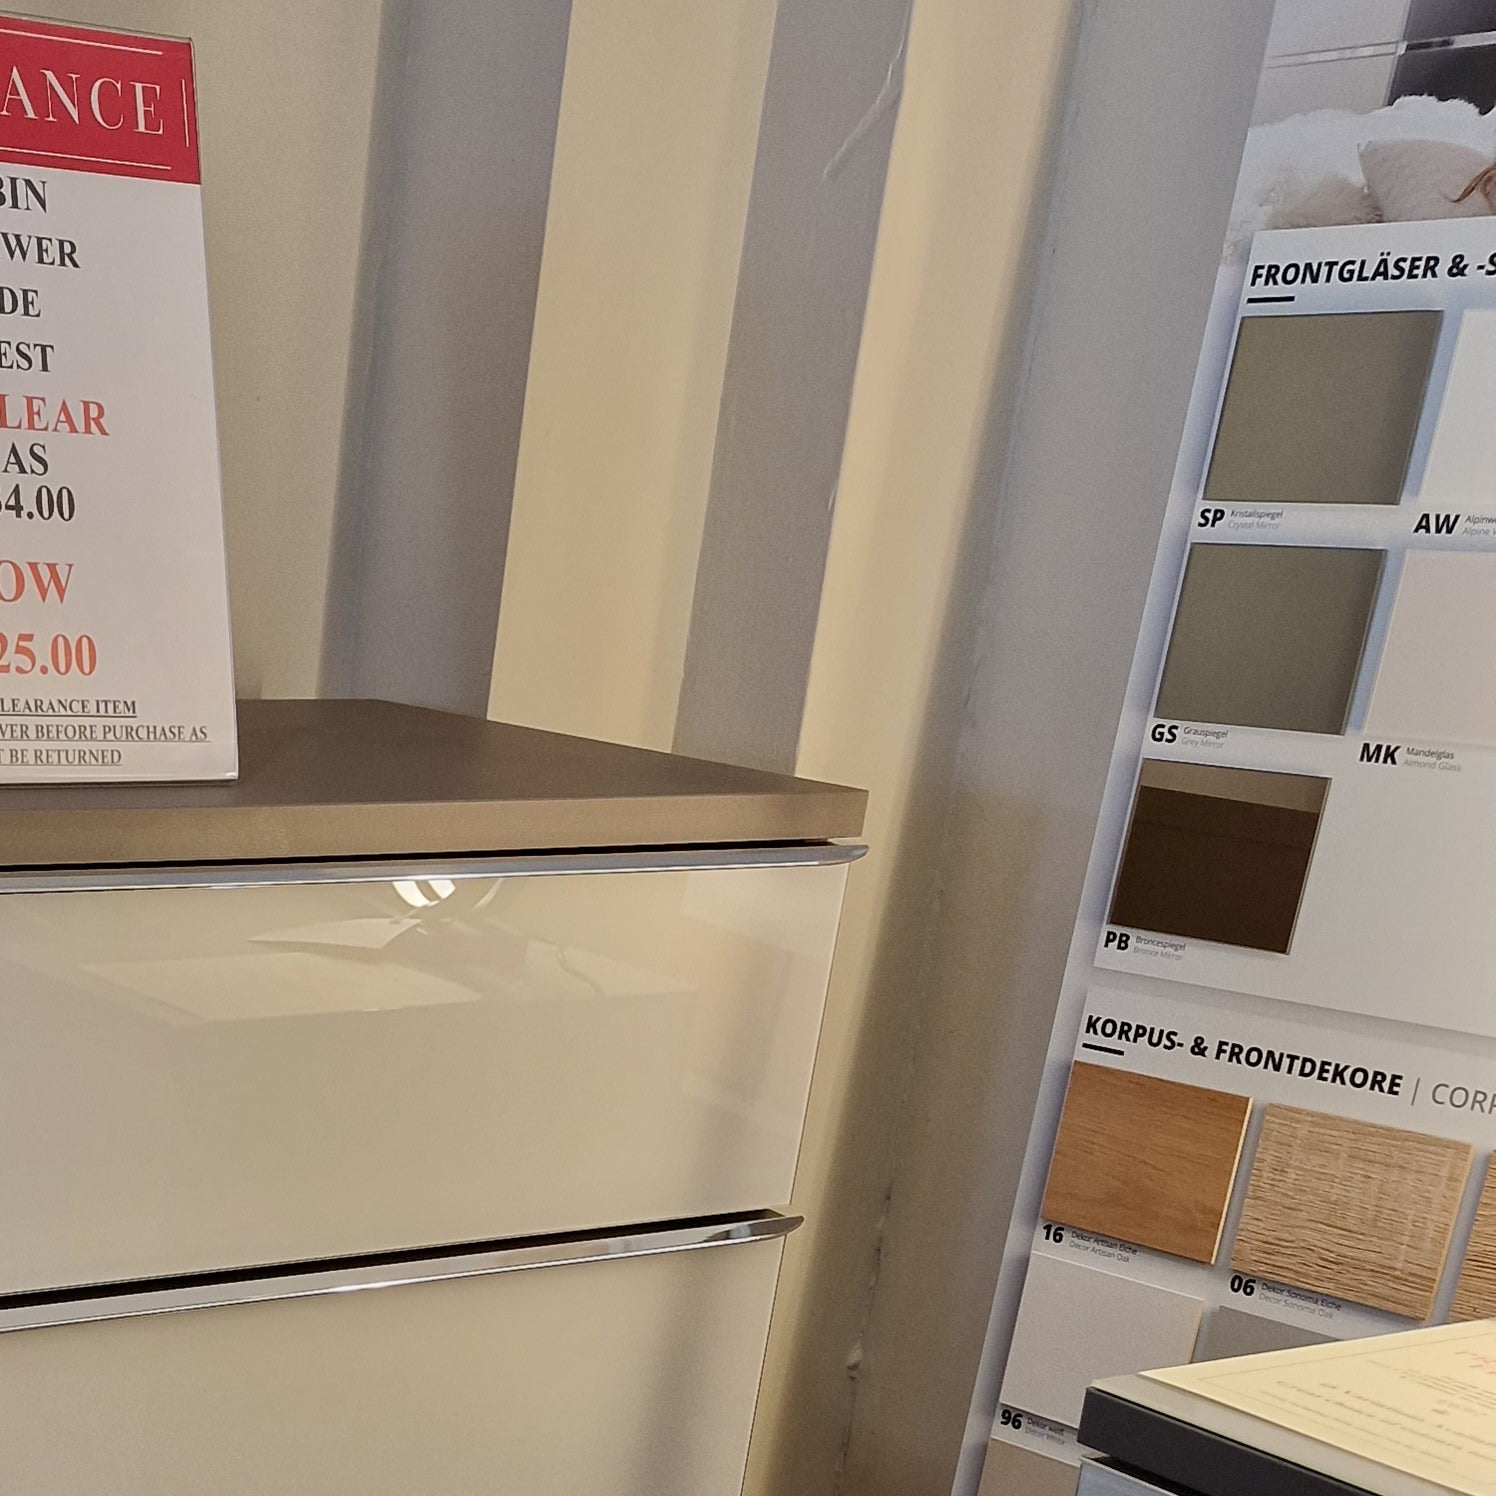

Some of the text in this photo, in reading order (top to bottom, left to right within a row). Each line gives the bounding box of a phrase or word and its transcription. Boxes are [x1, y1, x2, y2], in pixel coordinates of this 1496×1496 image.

[1249, 251, 1440, 287] FRONTGLÄSER
[1446, 253, 1470, 278] &
[1197, 508, 1226, 528] SP
[1412, 513, 1461, 535] AW
[95, 699, 137, 715] ITEM
[35, 724, 97, 740] BEFORE
[102, 724, 185, 741] PURCHASE
[189, 725, 208, 741] AS
[1151, 723, 1179, 744] GS
[9, 748, 30, 764] BE
[34, 749, 122, 765] RETURNED
[1359, 742, 1455, 766] MK Mandelglas
[1104, 930, 1131, 951] PB
[1085, 1014, 1184, 1051] KORPUS-
[1189, 1035, 1209, 1059] &
[1214, 1039, 1405, 1097] FRONTDEKORE
[1042, 1223, 1065, 1244] 16
[1230, 1274, 1257, 1297] 06
[1000, 1408, 1023, 1430] 96
